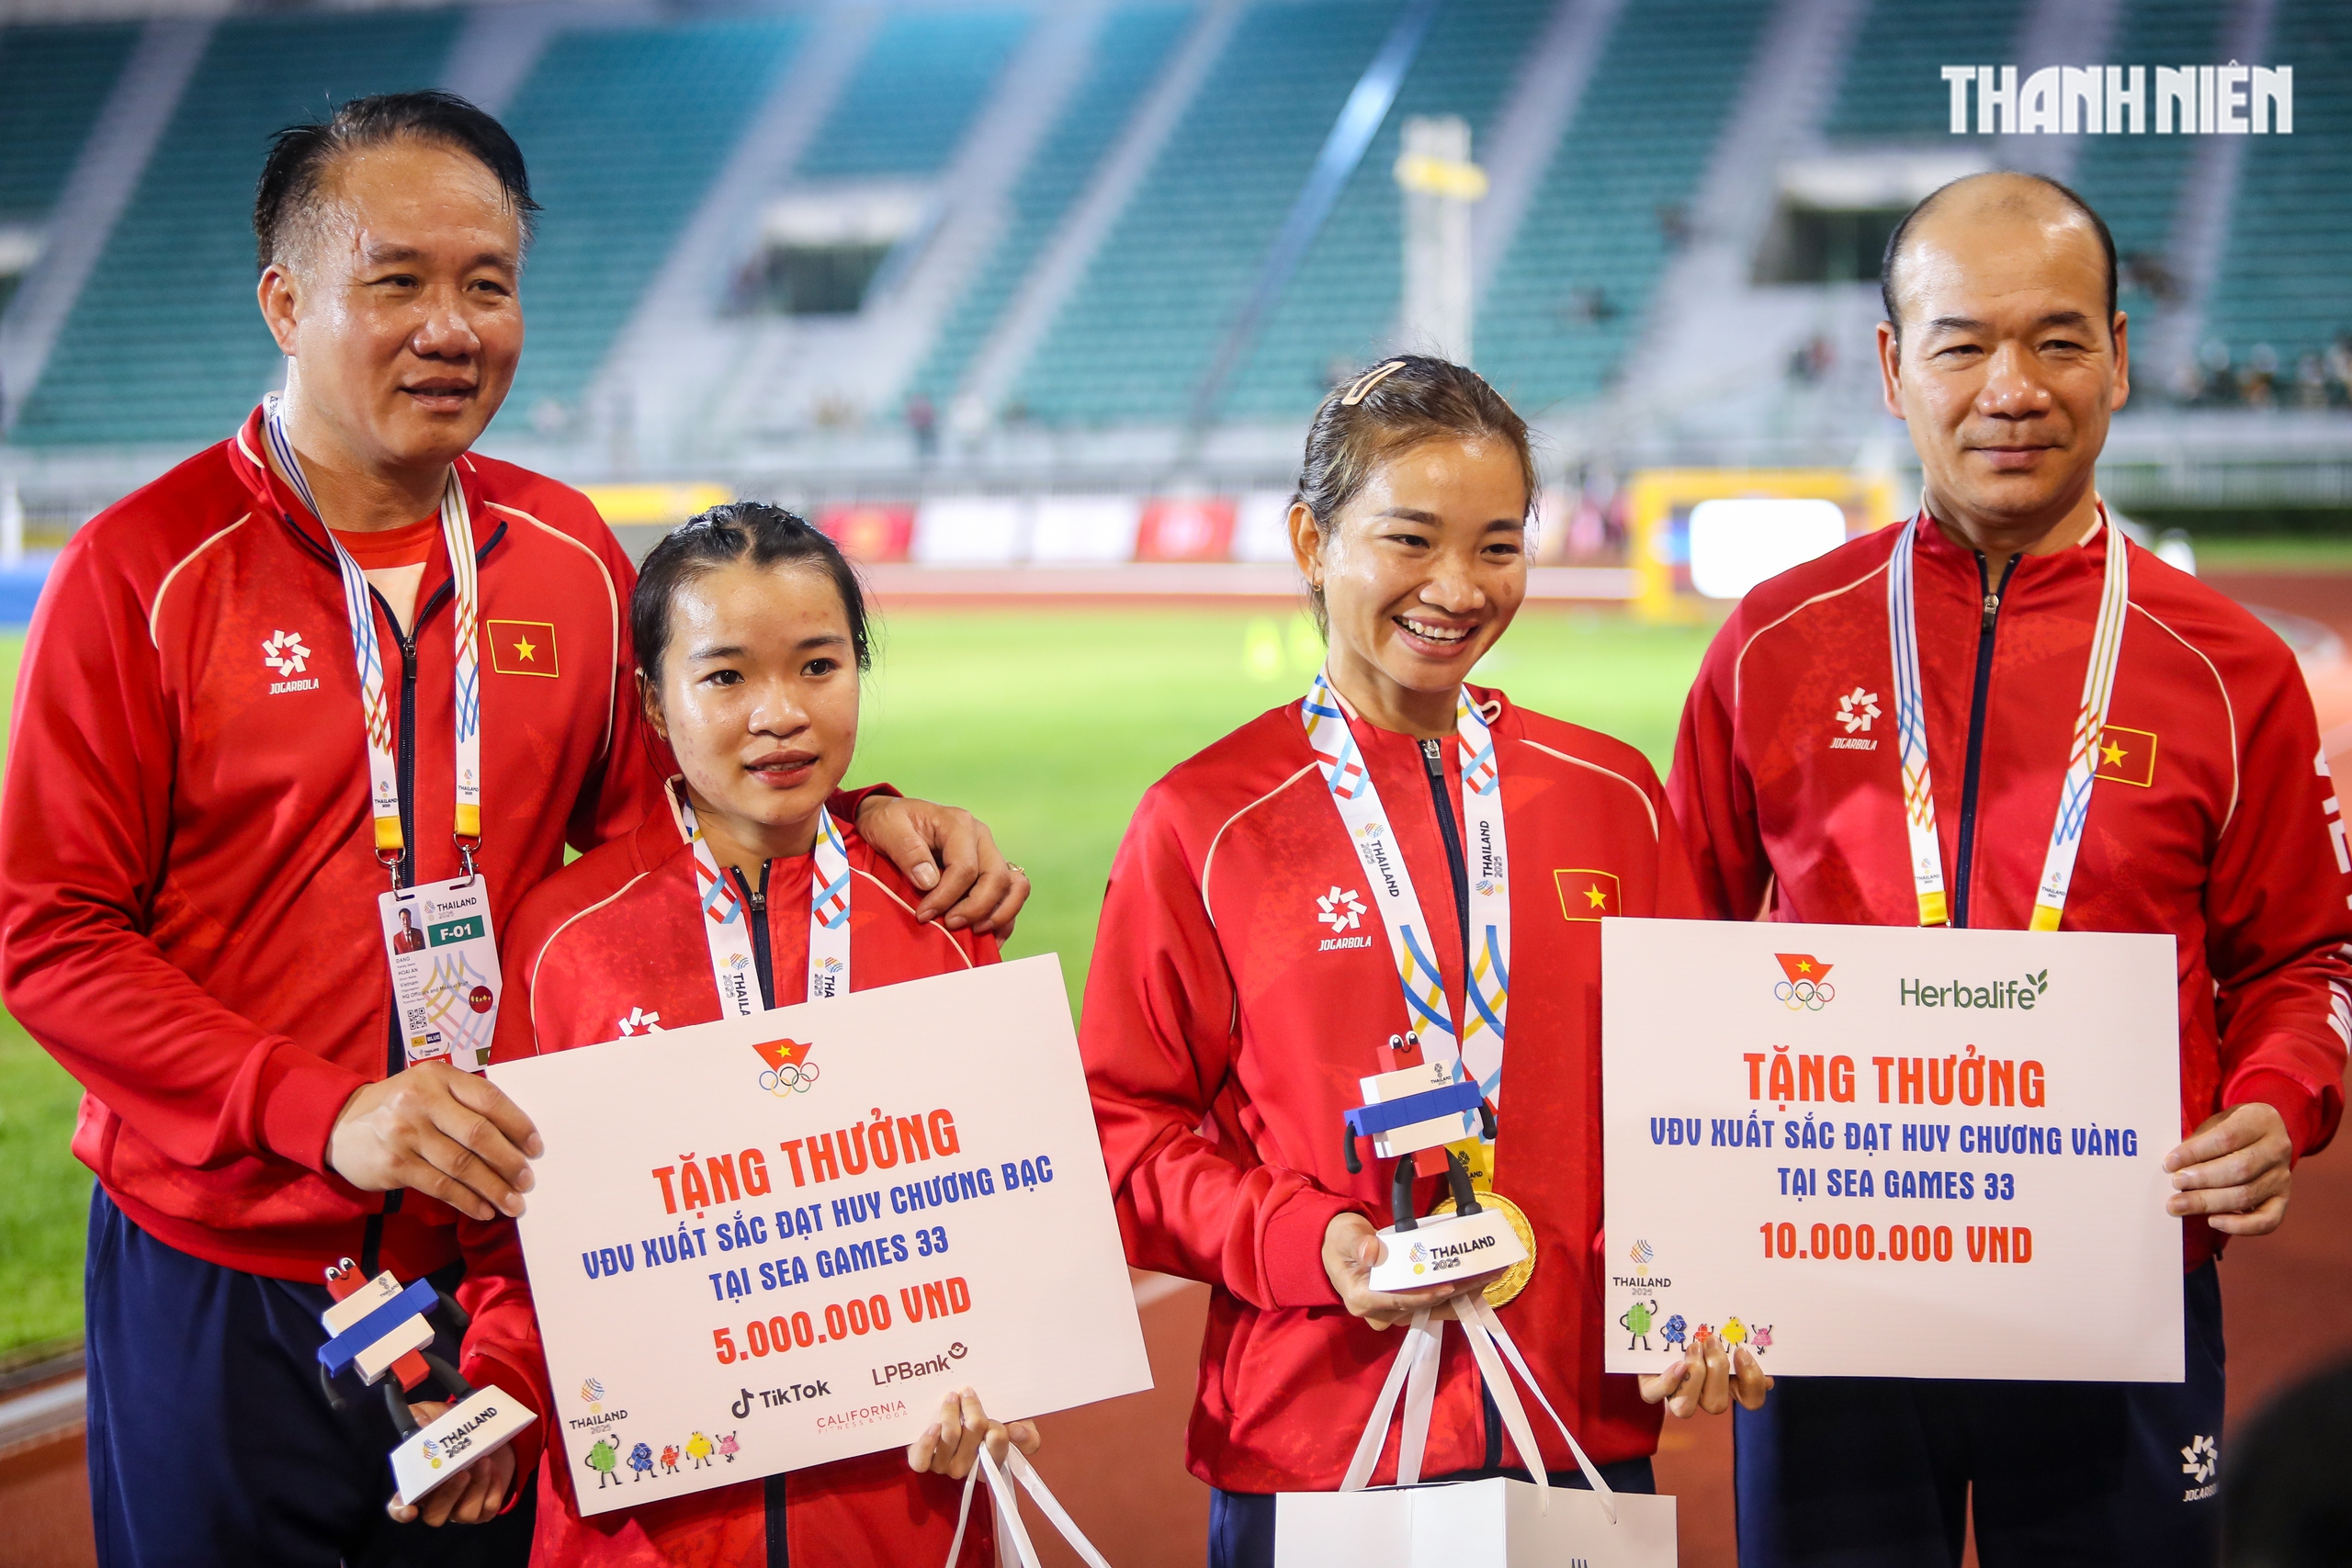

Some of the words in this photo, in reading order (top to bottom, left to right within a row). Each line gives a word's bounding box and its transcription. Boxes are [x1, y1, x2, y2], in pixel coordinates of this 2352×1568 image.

[268, 678, 320, 695] JOGARBOLA
[1829, 737, 1878, 751] JOGARBOLA
[1360, 842, 1375, 865] 2025
[1479, 820, 1494, 878] THAILAND
[1371, 840, 1400, 898] THAILAND
[1494, 855, 1504, 879] 2025
[1916, 874, 1941, 882] THAILAND
[2041, 886, 2067, 897] THAILAND
[436, 897, 478, 912] THAILAND
[1317, 935, 1373, 953] JOGARBOLA
[722, 974, 736, 999] 2025
[733, 972, 752, 1017] THAILA
[814, 974, 824, 997] 2025
[1900, 977, 2036, 1011] Herbalife
[426, 1033, 441, 1043] BLUE
[1430, 1075, 1453, 1084] THAILAND
[1743, 1044, 1856, 1112] TẶNG
[1871, 1043, 2047, 1109] THƯỞNG
[1650, 1117, 1702, 1147] VĐV
[1711, 1110, 1775, 1149] XUẤT
[1784, 1111, 1836, 1151] SẮC
[1844, 1122, 1893, 1158] ĐẠT
[1902, 1124, 1951, 1154] HUY
[1960, 1126, 2063, 1156] CHƯƠNG
[2072, 1122, 2138, 1157] VÀNG
[651, 1150, 772, 1220] TẶNG
[779, 1108, 961, 1189] THƯỞNG
[1778, 1168, 1817, 1202] TẠI
[1826, 1169, 1875, 1198] SEA
[1883, 1170, 1974, 1201] GAMES
[1984, 1172, 2015, 1201] 33
[582, 1243, 636, 1280] VĐV
[641, 1220, 707, 1269] XUẤT
[716, 1210, 768, 1252] SẮC
[775, 1202, 824, 1241] ĐẠT
[831, 1190, 881, 1228] HUY
[889, 1168, 996, 1215] CHƯƠNG
[1001, 1155, 1054, 1193] BẠC
[1429, 1235, 1497, 1260] THAILAND
[1759, 1222, 1953, 1262] 10.000.000
[1966, 1225, 2033, 1265] VND
[708, 1267, 752, 1304] TẠI
[758, 1256, 810, 1292] SEA
[815, 1234, 910, 1280] GAMES
[915, 1224, 950, 1258] 33
[1431, 1256, 1462, 1272] 2025
[1612, 1277, 1672, 1288] THAILAND
[1631, 1287, 1653, 1296] 2025
[712, 1293, 893, 1366] 5.000.000
[900, 1275, 973, 1325] VND
[871, 1353, 952, 1386] LPBank
[759, 1379, 832, 1409] TikTok
[569, 1409, 628, 1430] THAILAND
[816, 1399, 907, 1429] CALIFORNIA
[877, 1409, 909, 1422] YOGA
[439, 1405, 499, 1450] THAILAND
[590, 1423, 612, 1435] 2025
[445, 1437, 473, 1460] 2025
